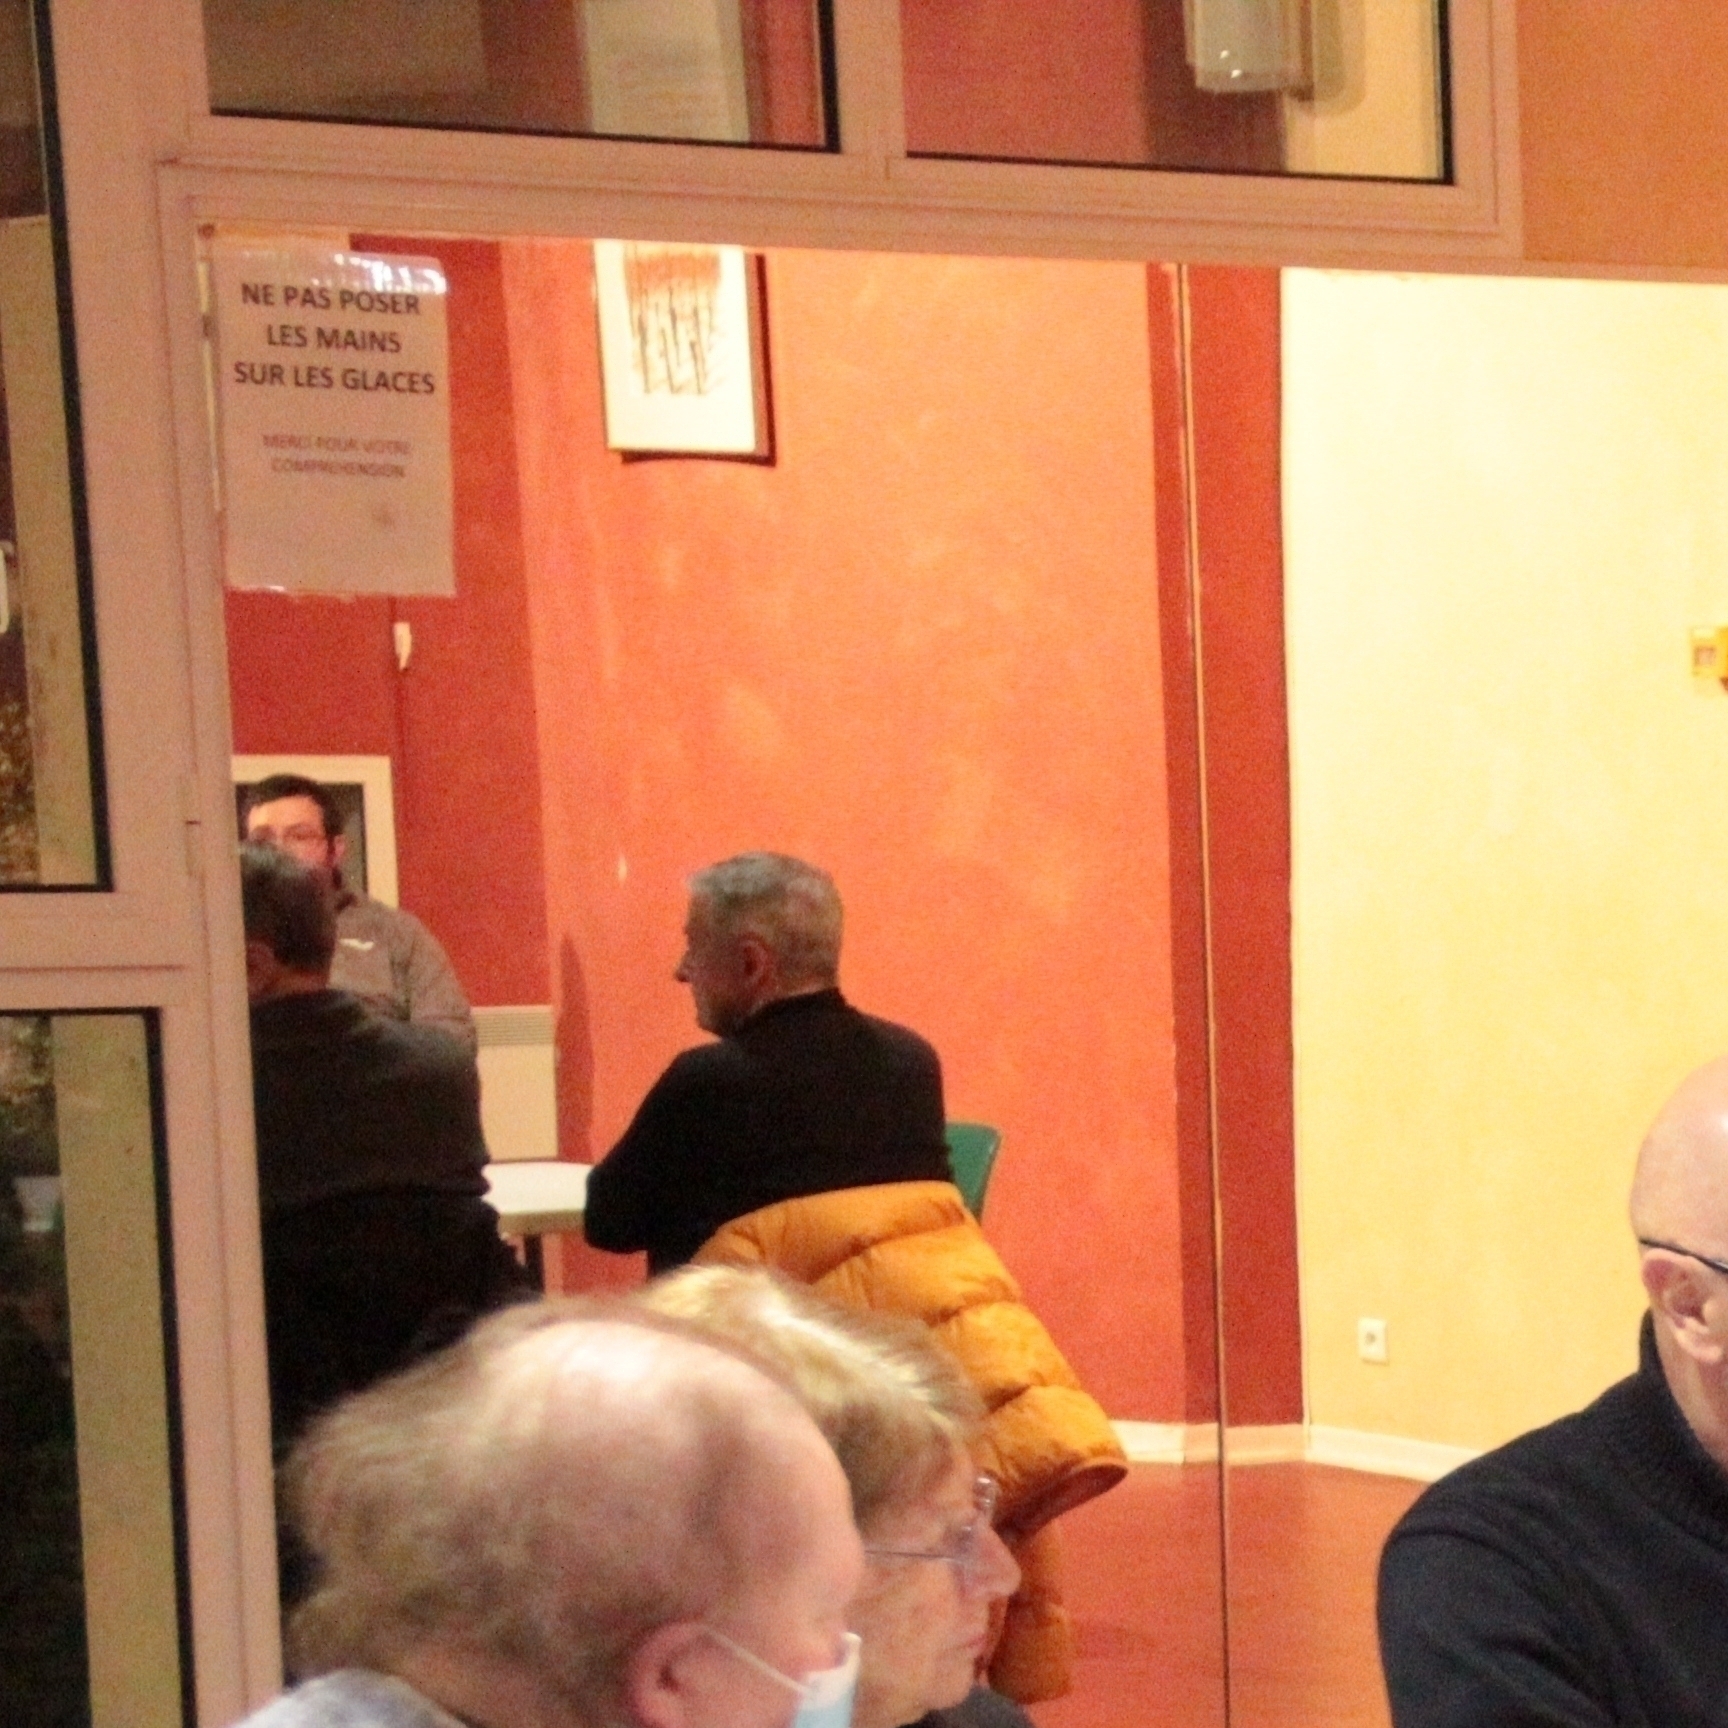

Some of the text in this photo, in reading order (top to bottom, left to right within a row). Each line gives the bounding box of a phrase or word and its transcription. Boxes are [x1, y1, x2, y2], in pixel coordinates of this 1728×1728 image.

[242, 283, 420, 315] NE PAS POSER
[267, 324, 401, 353] LES MAINS
[234, 361, 436, 394] SUR LES GLACES
